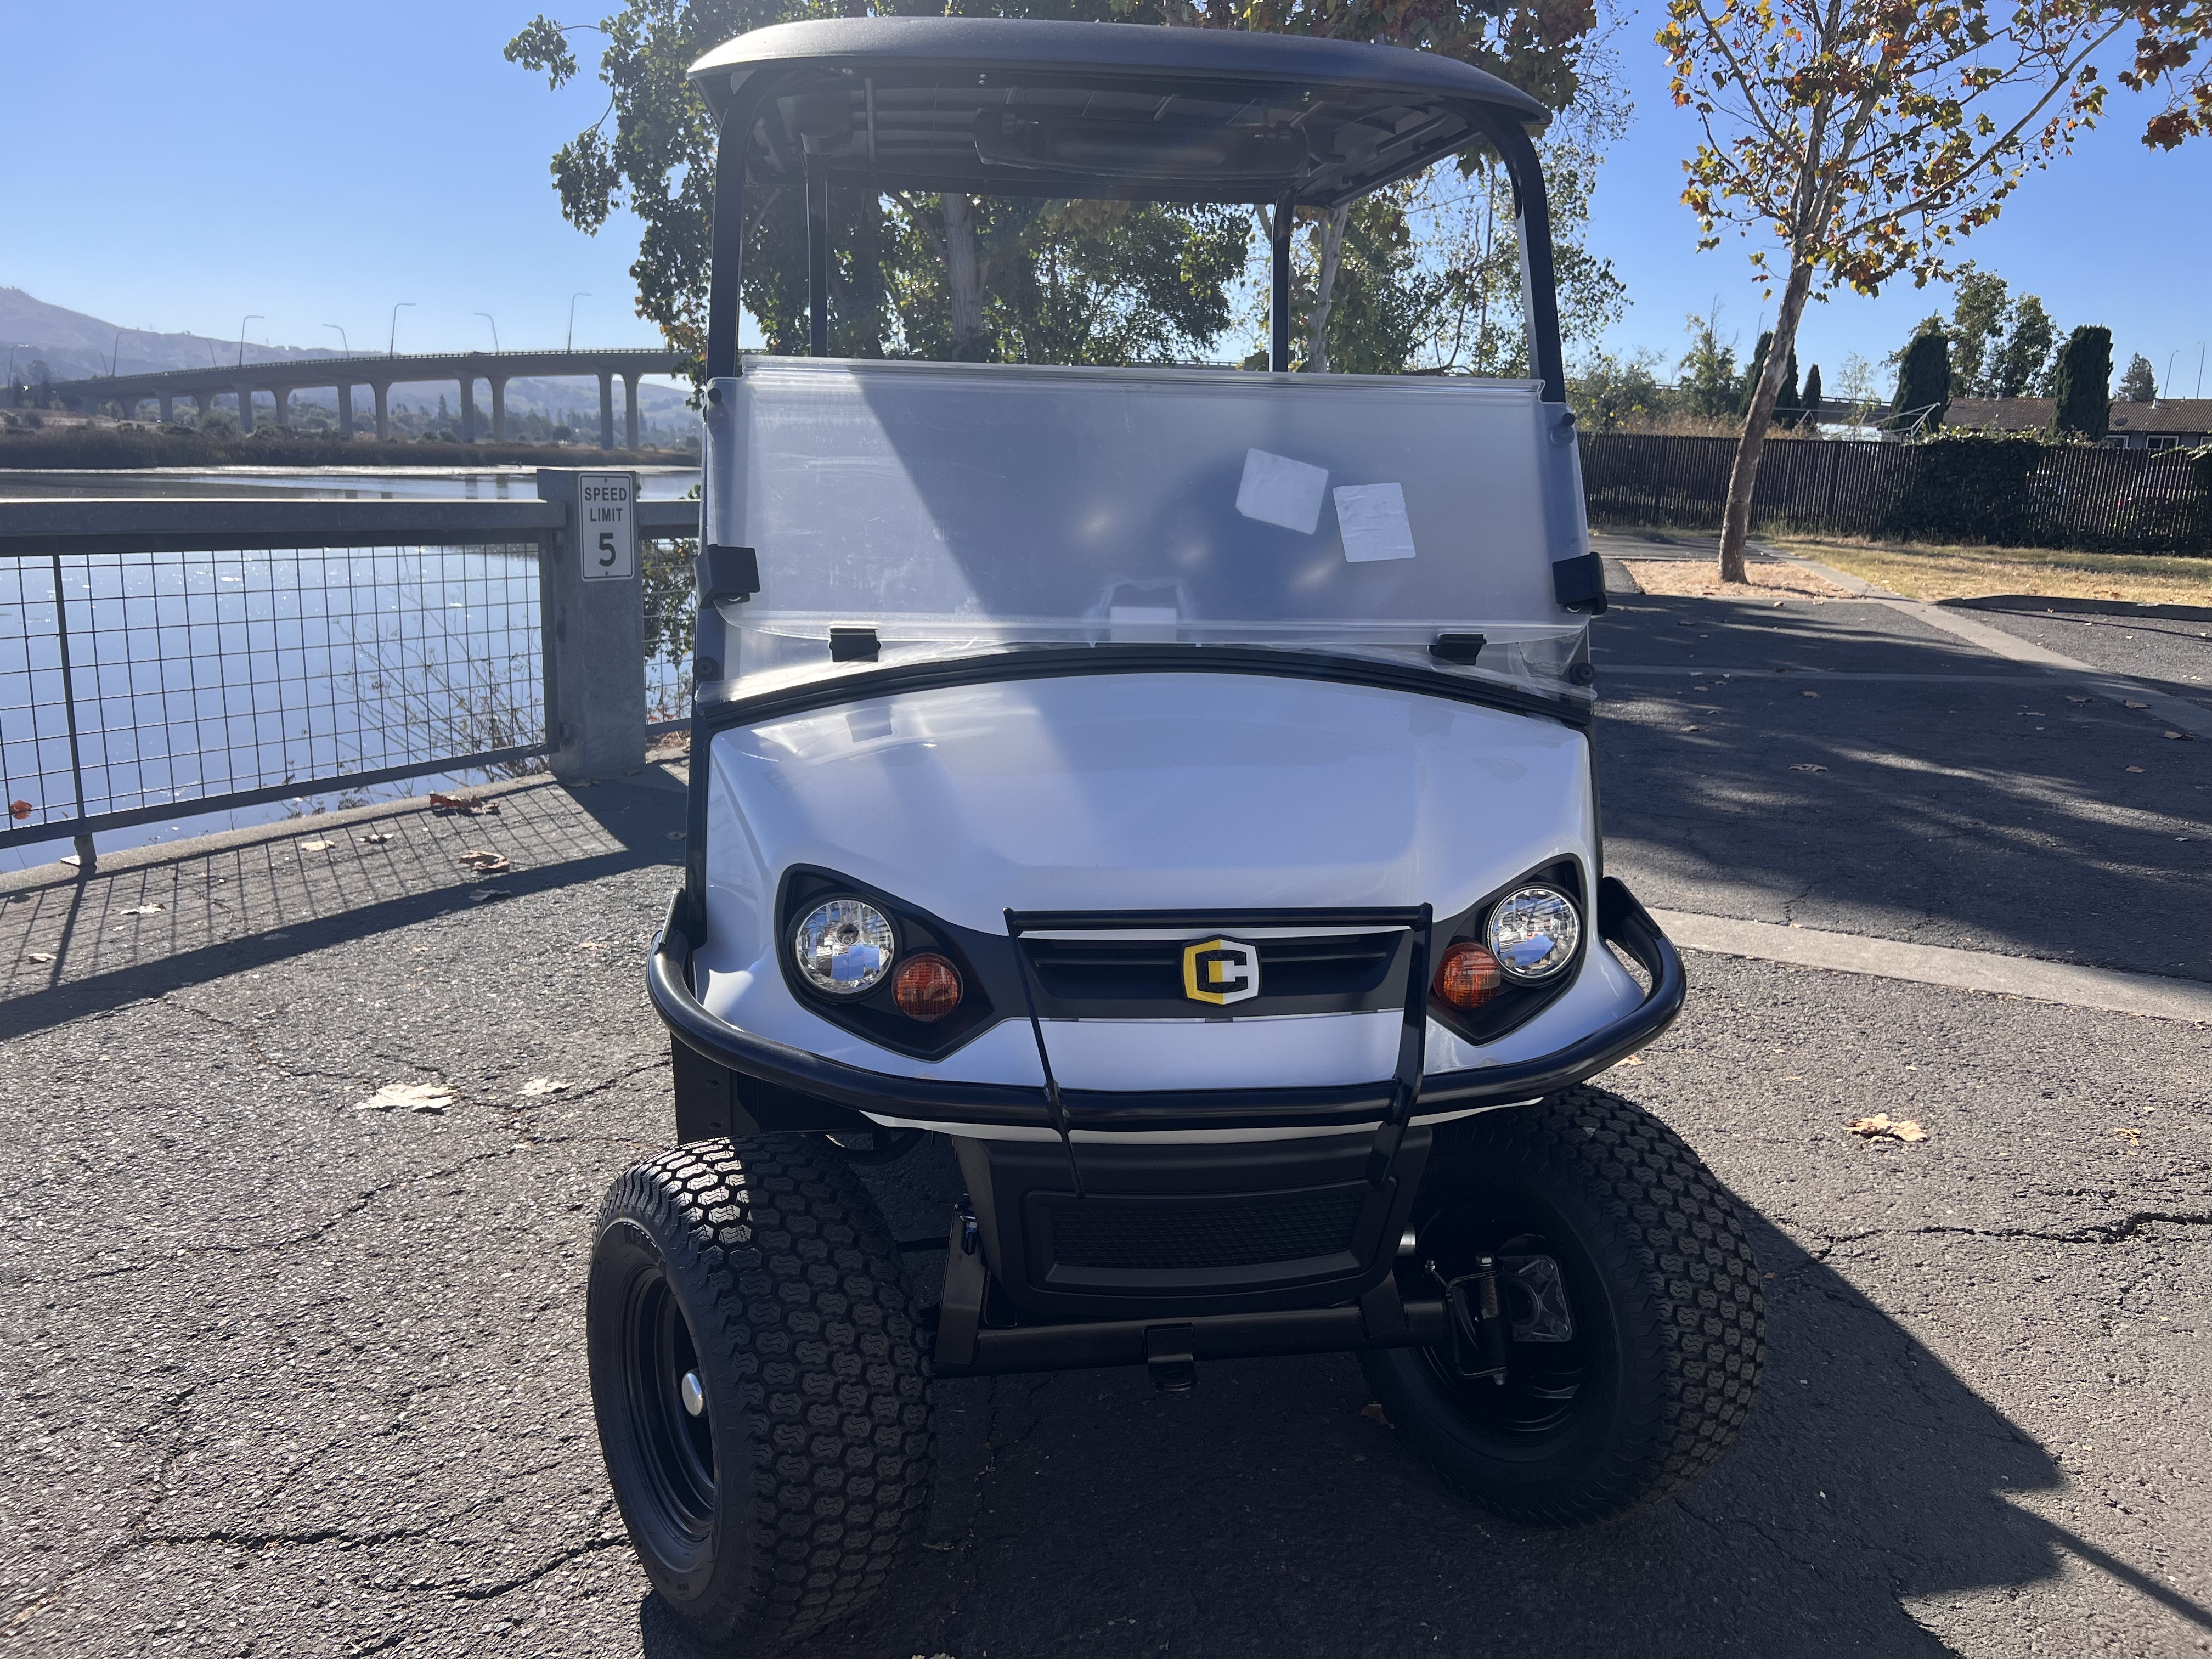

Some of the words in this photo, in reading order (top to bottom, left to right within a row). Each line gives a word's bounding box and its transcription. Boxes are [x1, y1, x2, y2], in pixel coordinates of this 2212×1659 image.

[585, 487, 627, 501] SPEED
[590, 508, 623, 522] LIMIT
[599, 533, 616, 566] 5
